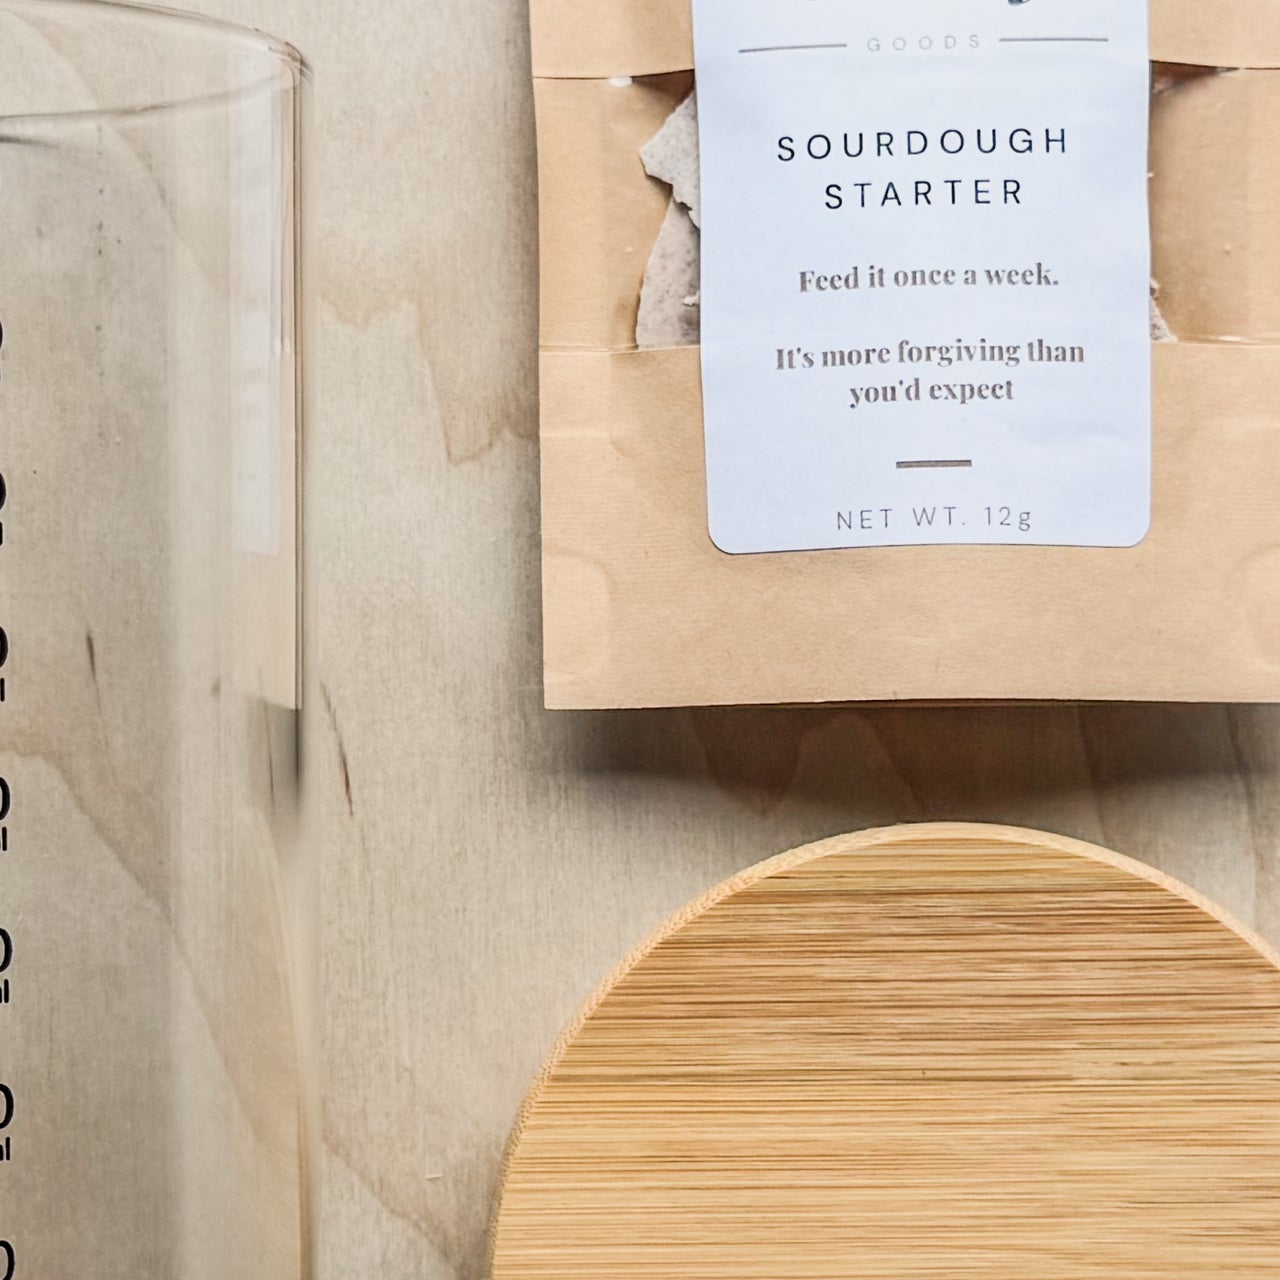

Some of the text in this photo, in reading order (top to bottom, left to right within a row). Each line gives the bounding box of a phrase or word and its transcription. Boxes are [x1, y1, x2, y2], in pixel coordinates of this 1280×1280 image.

[866, 33, 982, 52] GOODS
[776, 127, 1068, 162] SOURDOUGH
[824, 178, 1023, 209] STARTER
[799, 262, 1060, 292] Feed it once a week.
[775, 339, 1085, 370] It's more forgiving than
[848, 379, 1014, 408] you'd expect
[835, 505, 1032, 531] NET WT. 12g
